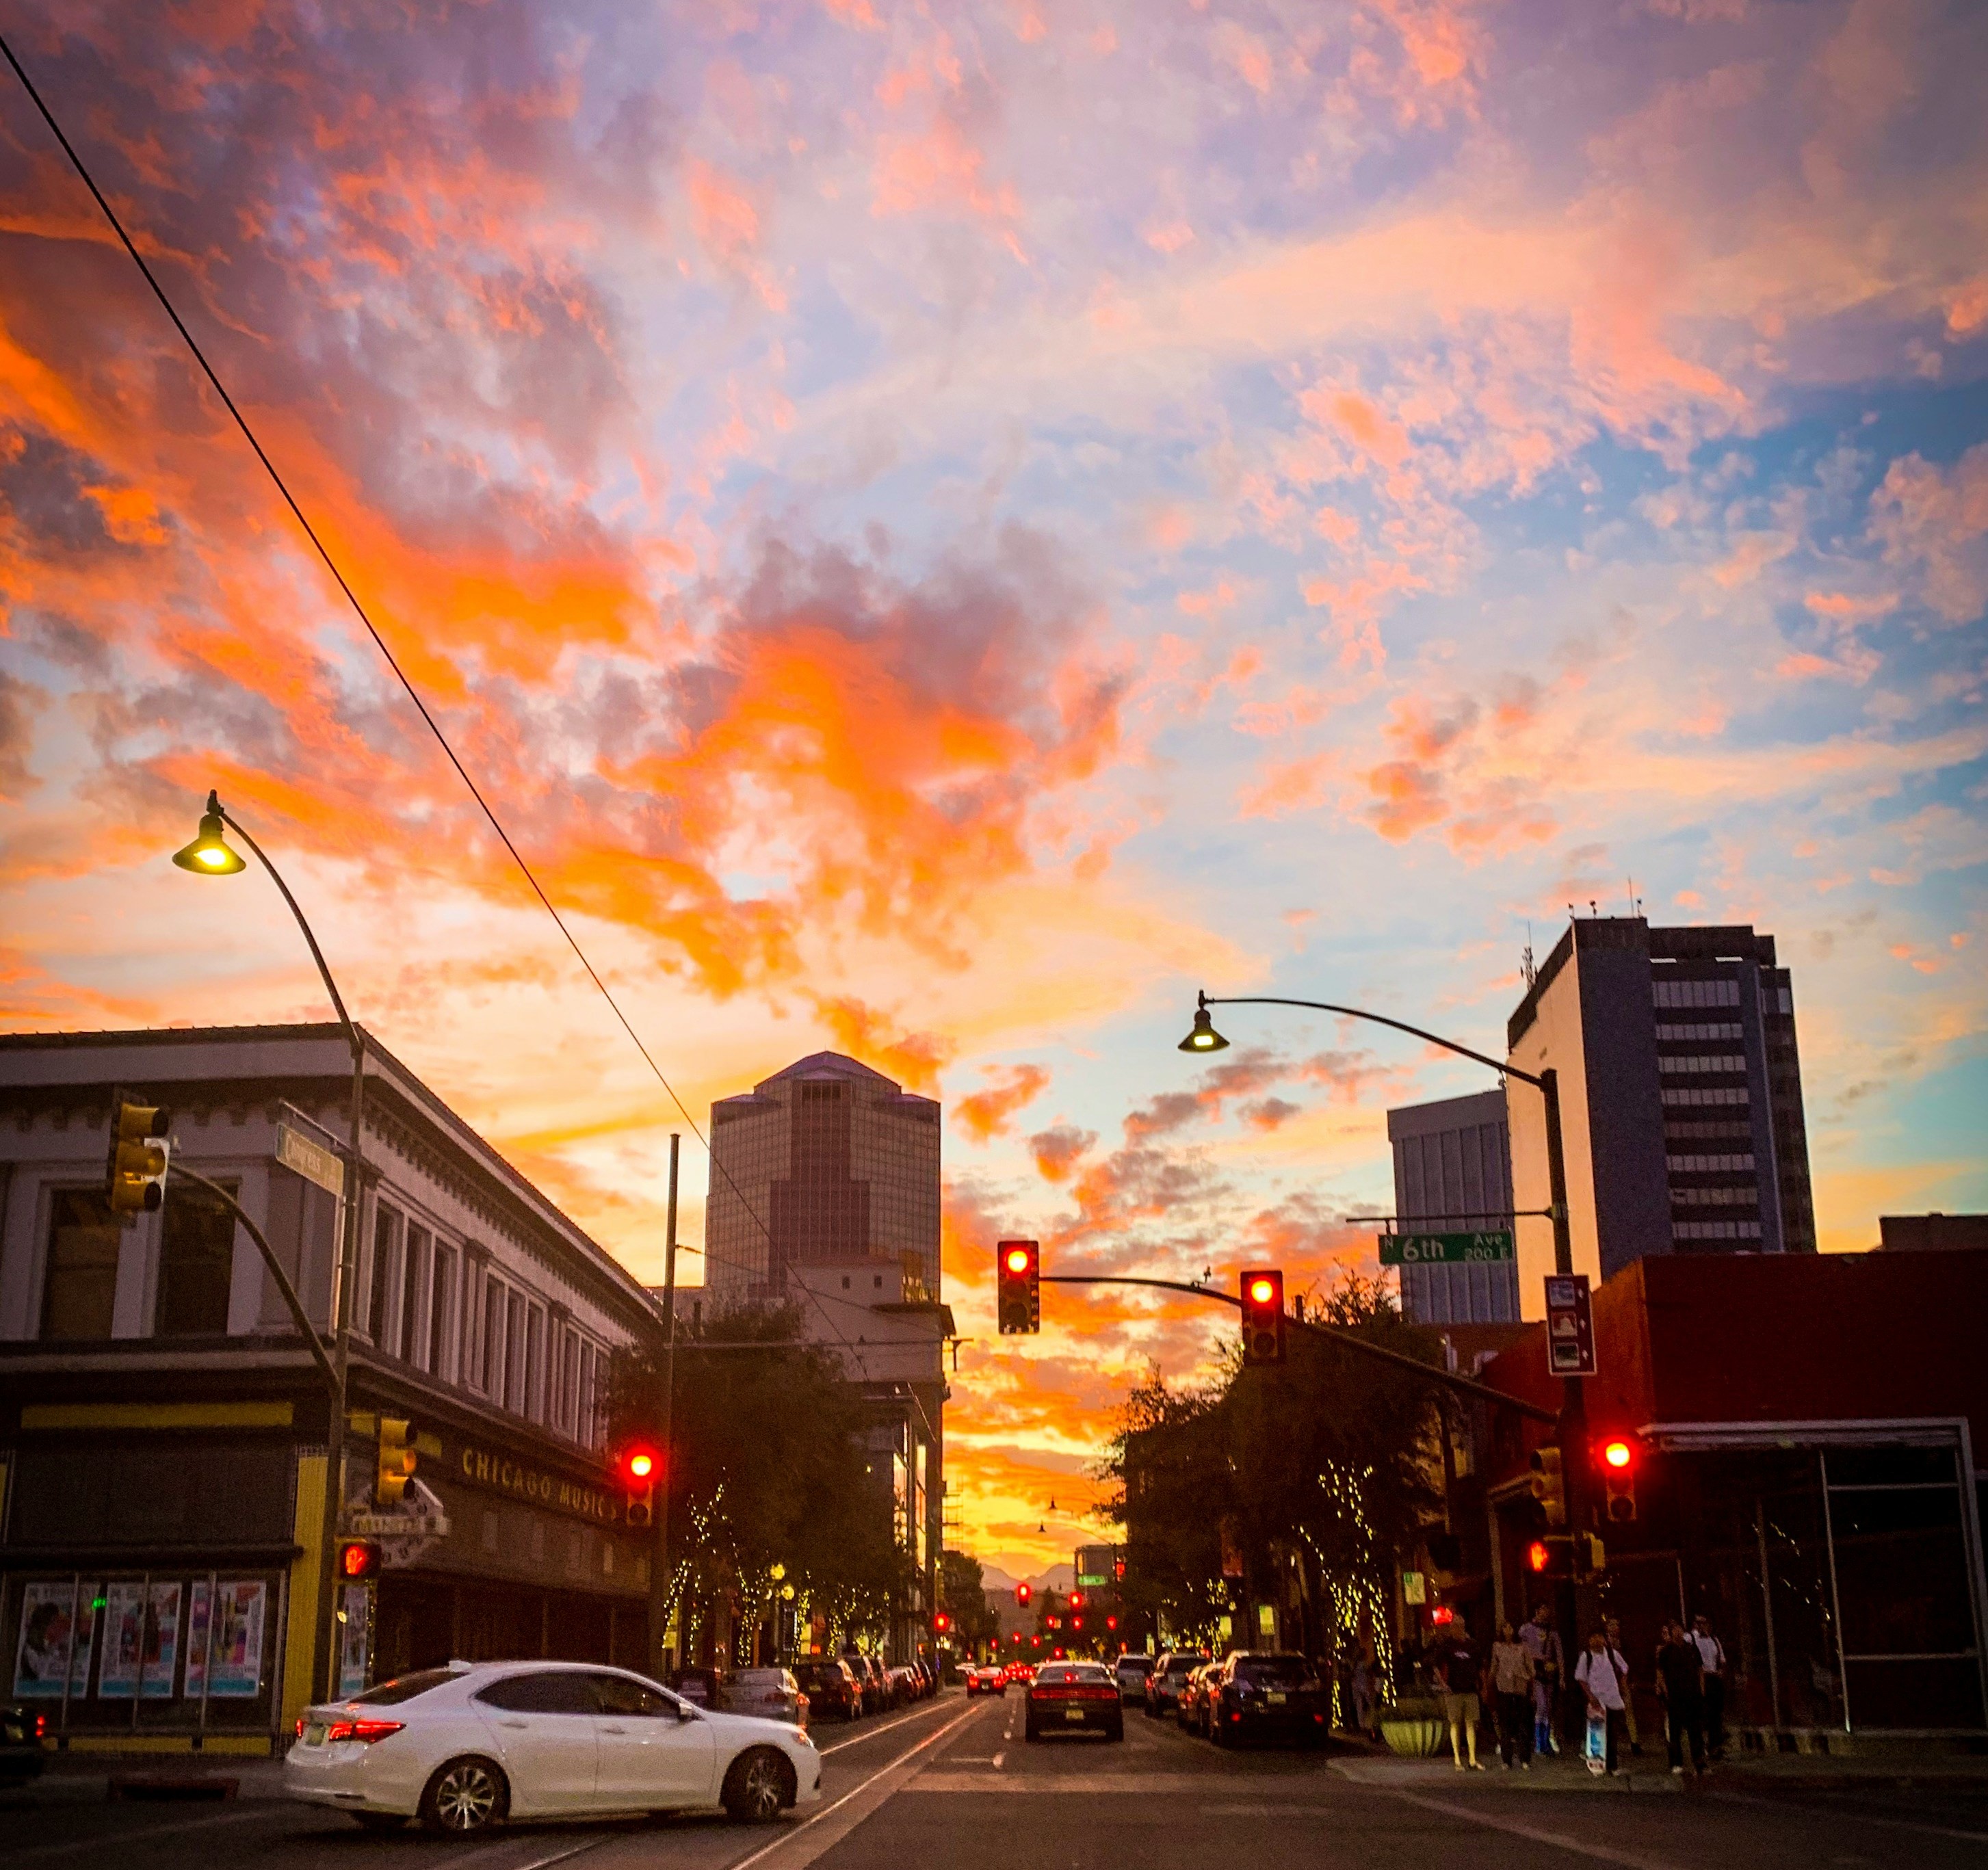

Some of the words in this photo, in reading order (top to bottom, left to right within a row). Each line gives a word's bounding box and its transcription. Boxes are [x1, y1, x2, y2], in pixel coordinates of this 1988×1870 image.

[1384, 1236, 1394, 1249] N
[1403, 1237, 1445, 1261] 6th
[1474, 1234, 1503, 1246] Ave
[463, 1448, 551, 1499] CHICAGO
[560, 1482, 605, 1518] MUSIC
